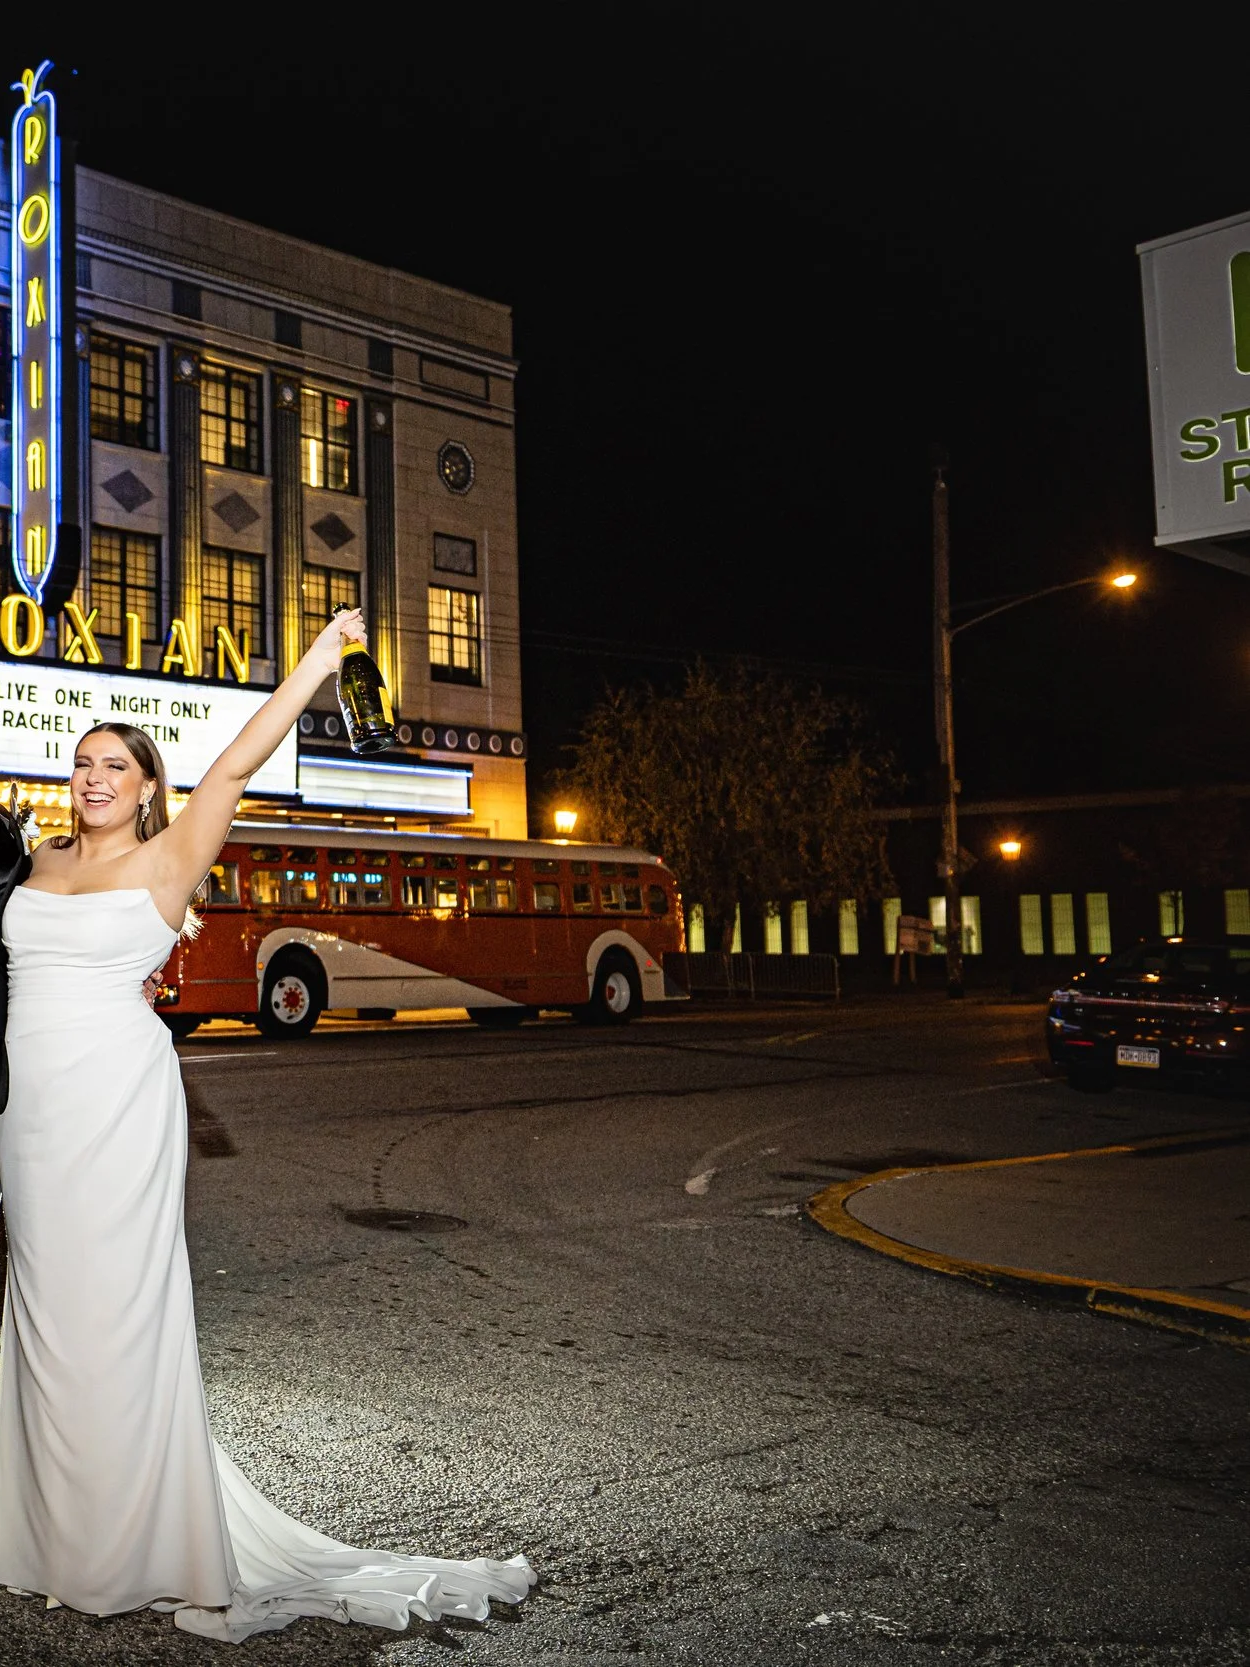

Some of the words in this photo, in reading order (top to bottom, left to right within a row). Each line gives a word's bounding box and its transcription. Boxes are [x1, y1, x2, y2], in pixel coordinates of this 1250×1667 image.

[18, 115, 50, 578] ROXIAN
[55, 688, 92, 709] ONE
[110, 694, 161, 716] NIGHT
[170, 701, 211, 720] ONLY
[2, 710, 76, 734] RACHEL
